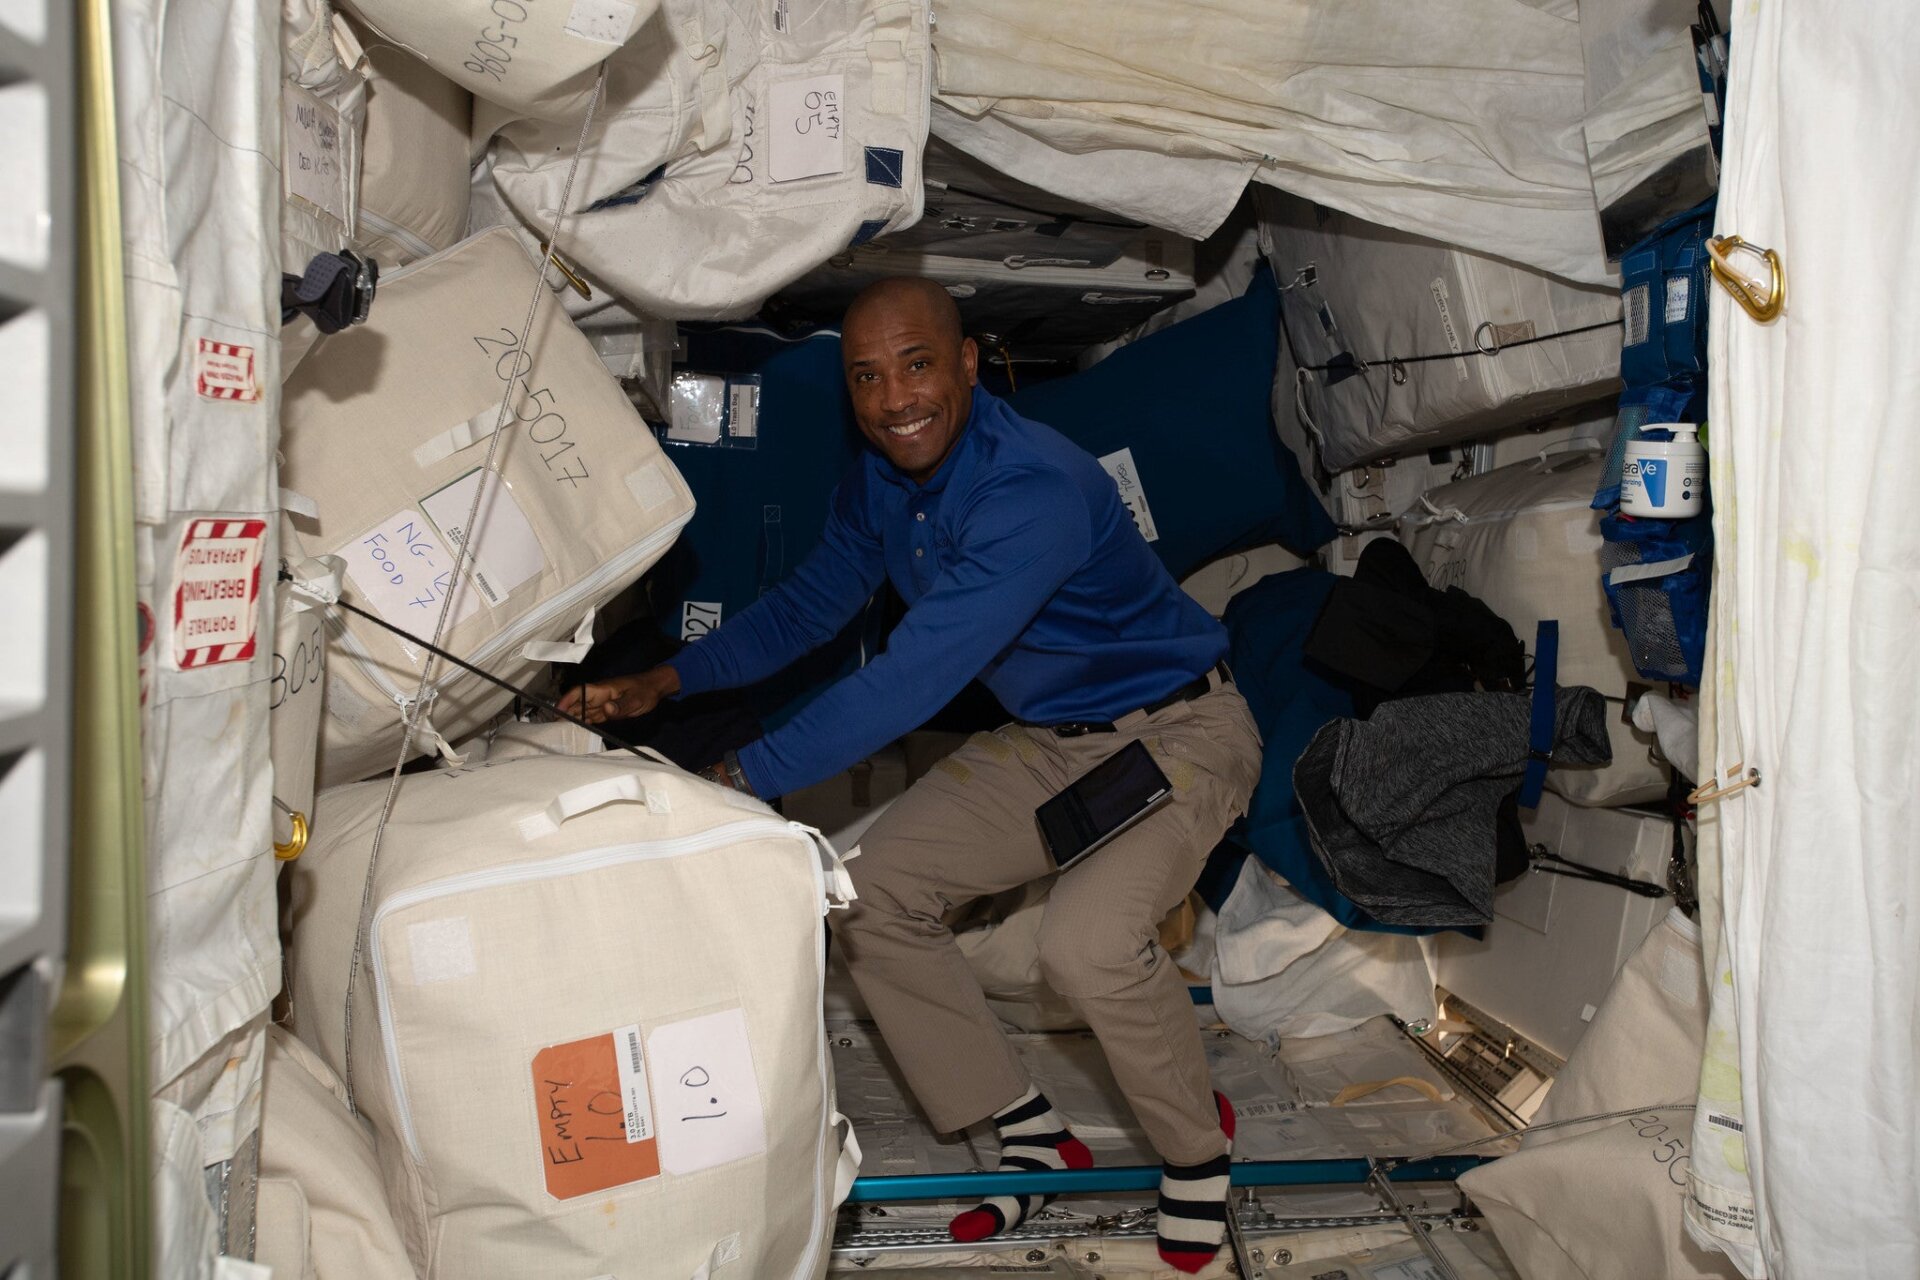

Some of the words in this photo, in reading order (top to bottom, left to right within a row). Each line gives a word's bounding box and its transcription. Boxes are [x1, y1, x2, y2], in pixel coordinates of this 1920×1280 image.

[795, 91, 823, 135] 65
[824, 91, 840, 140] EMPTY
[188, 547, 247, 565] APPARATUS
[363, 533, 404, 586] FOOD
[184, 578, 246, 602] BREATHING
[188, 615, 236, 636] PORTABLE
[680, 1066, 728, 1121] 1.0
[544, 1080, 584, 1165] EMPTY
[1727, 1219, 1753, 1231] Privacy
[1728, 1205, 1739, 1213] NA
